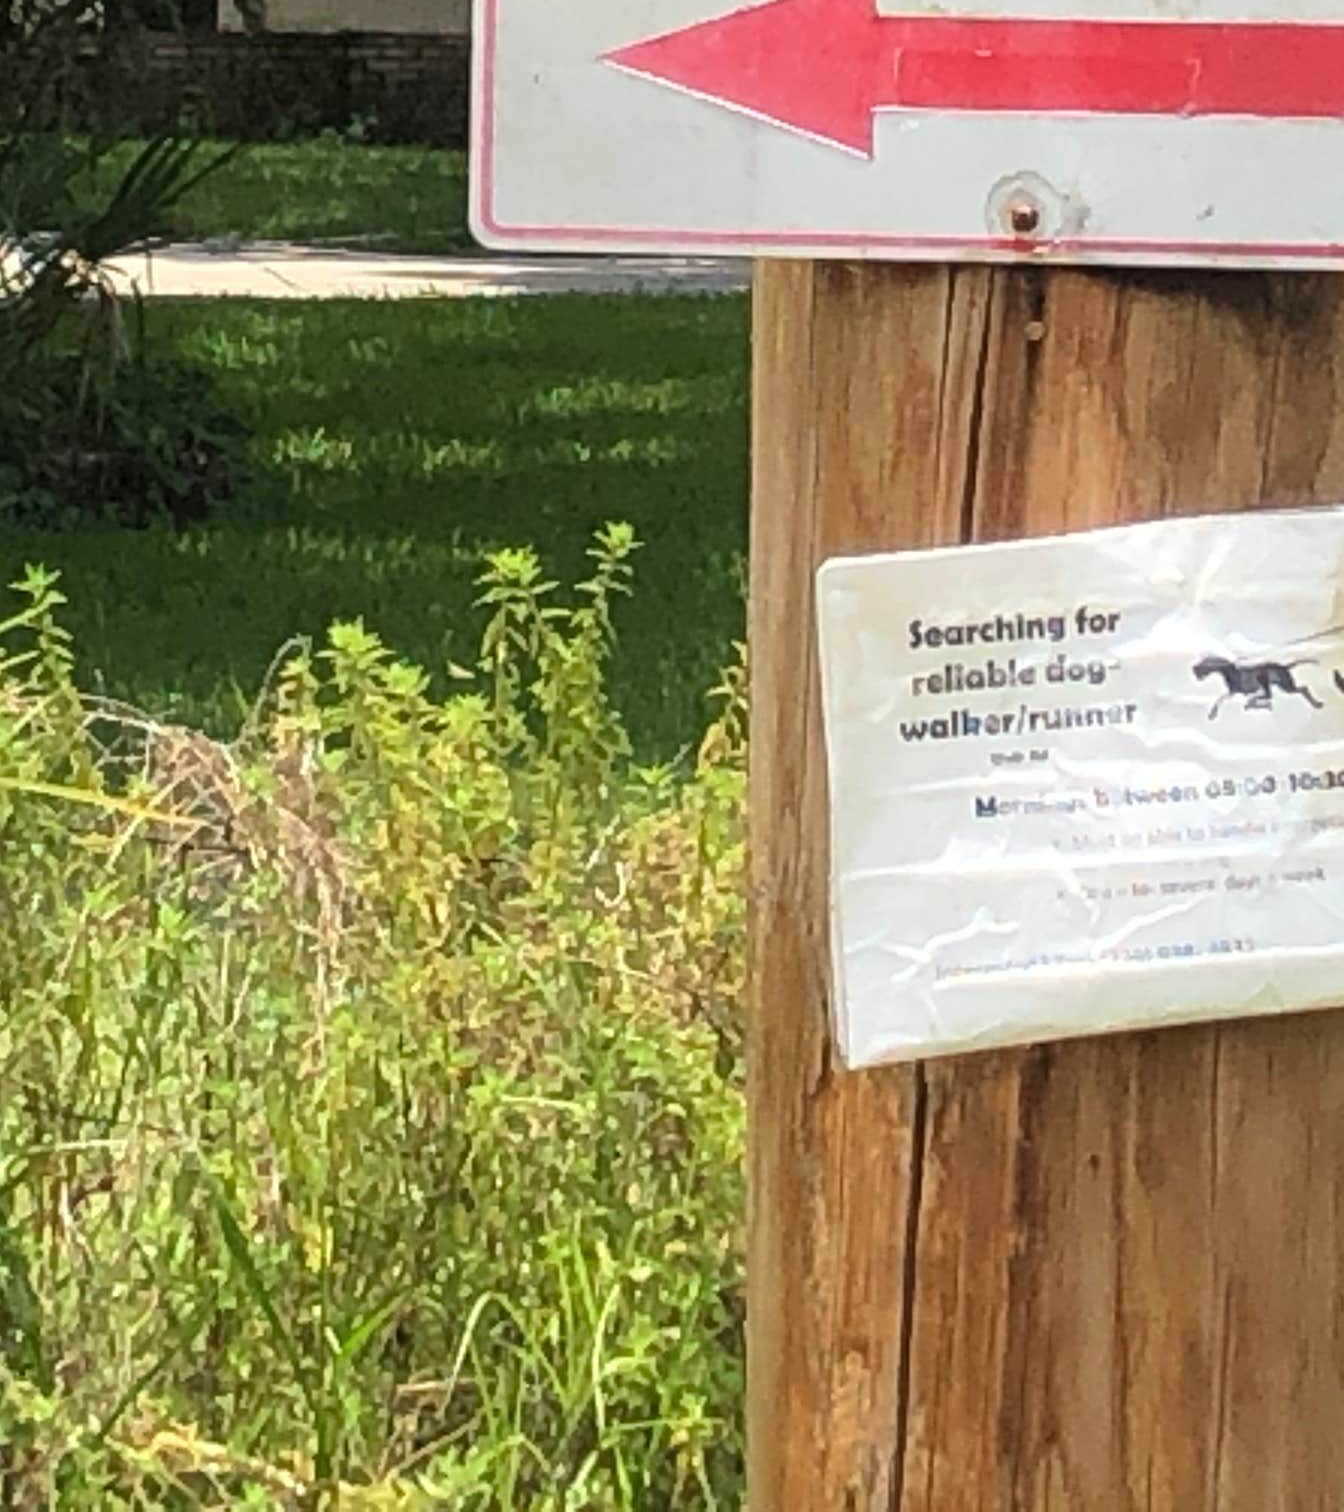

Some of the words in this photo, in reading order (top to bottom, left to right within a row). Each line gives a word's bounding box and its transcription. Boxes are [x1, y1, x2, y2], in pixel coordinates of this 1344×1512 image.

[909, 613, 1066, 649] Searching
[1074, 605, 1121, 635] for
[912, 658, 1037, 696] reliable
[899, 703, 1137, 742] walker/runner
